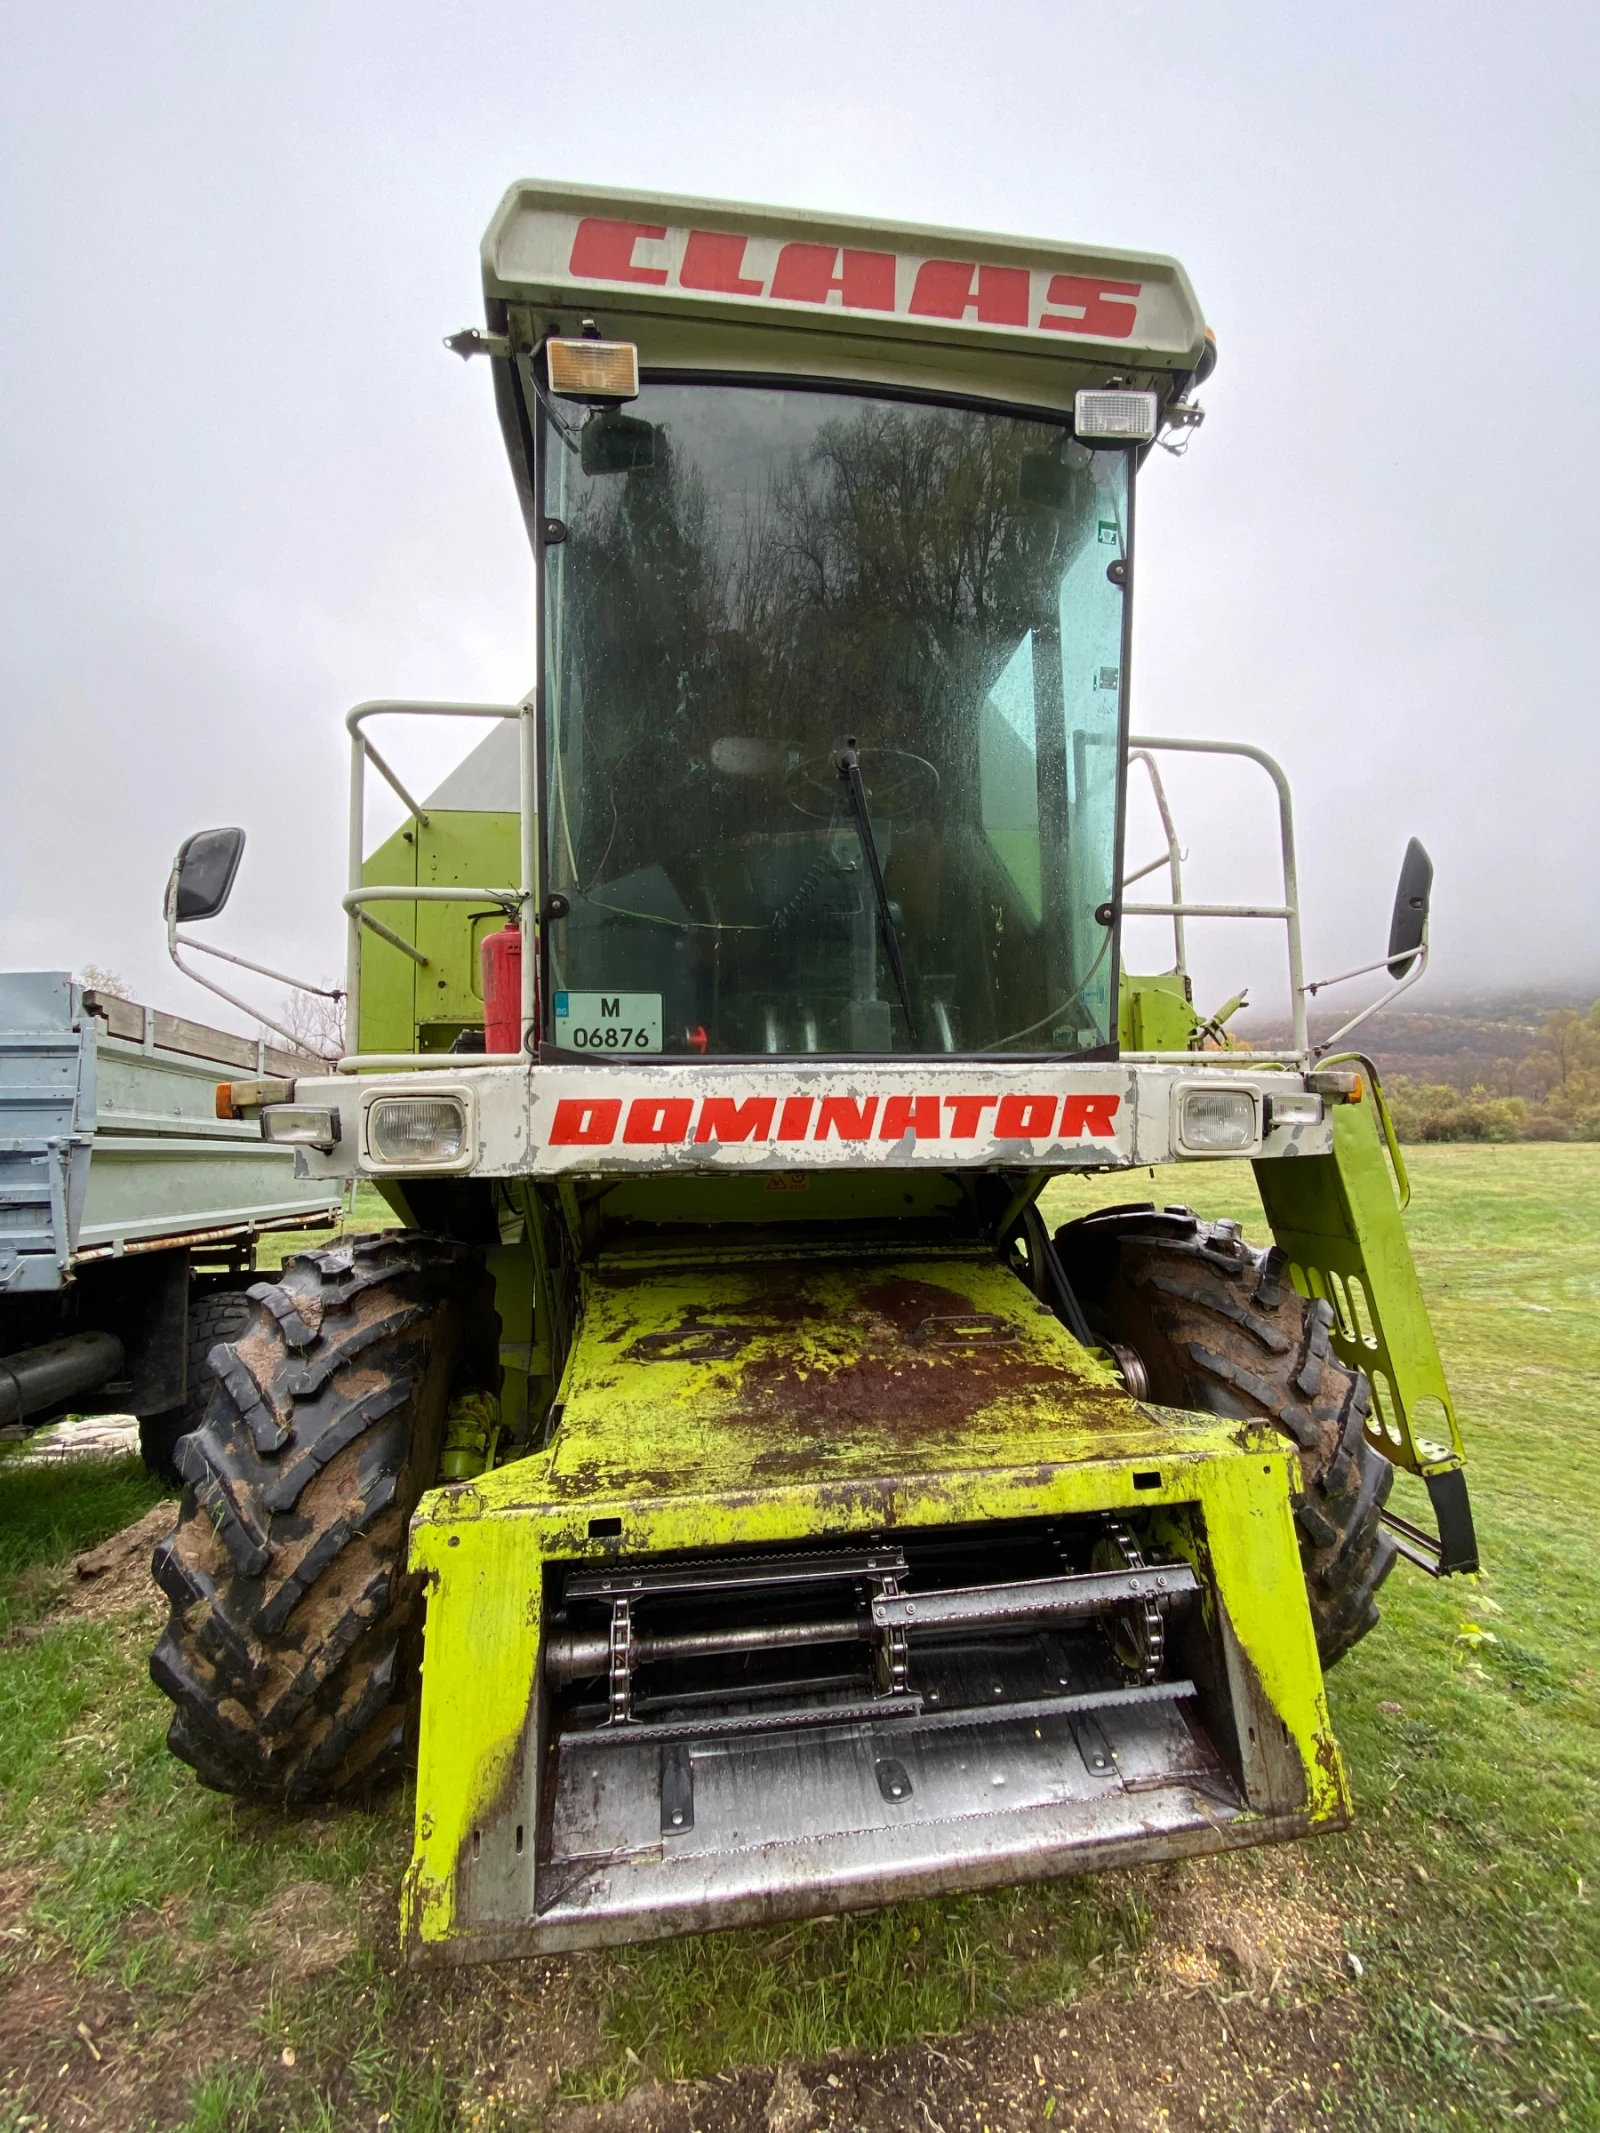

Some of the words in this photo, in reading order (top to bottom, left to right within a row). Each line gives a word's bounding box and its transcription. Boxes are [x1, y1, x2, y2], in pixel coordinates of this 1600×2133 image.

[569, 218, 1141, 338] CLAAS
[556, 1007, 567, 1015] BG
[601, 998, 620, 1017] M
[573, 1028, 649, 1048] 06876
[549, 1094, 1121, 1146] DOMINATOR
